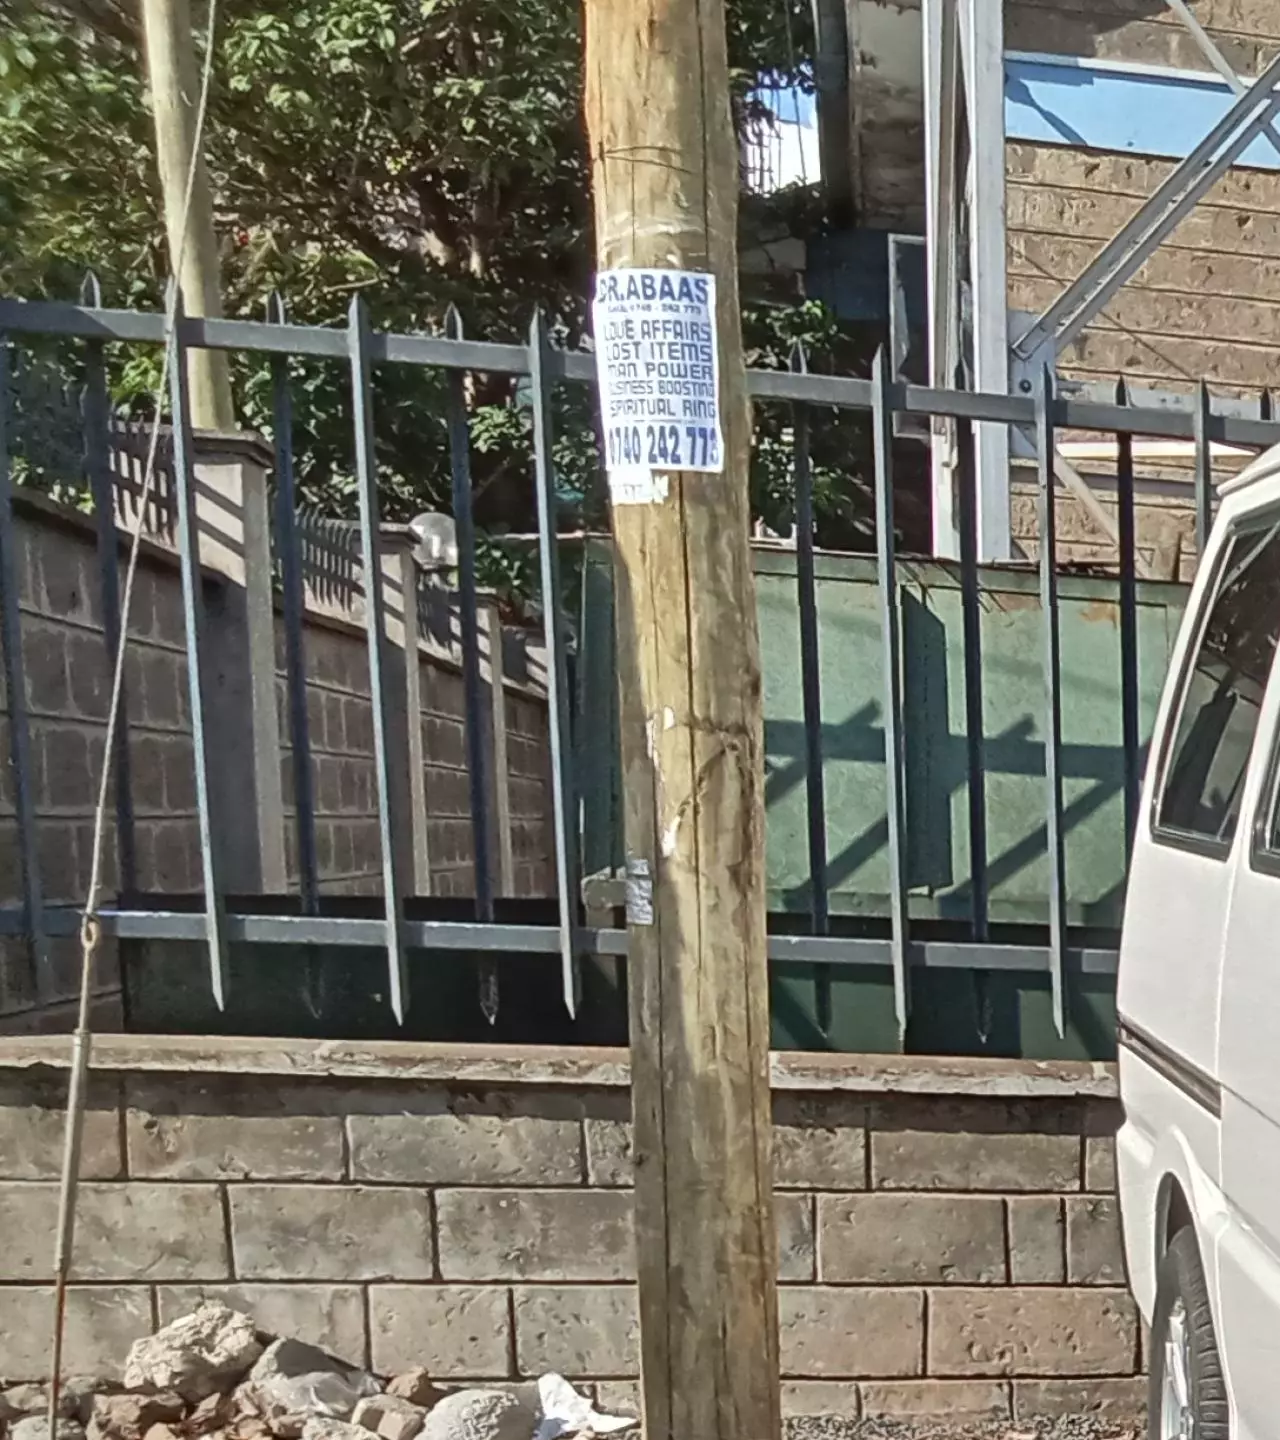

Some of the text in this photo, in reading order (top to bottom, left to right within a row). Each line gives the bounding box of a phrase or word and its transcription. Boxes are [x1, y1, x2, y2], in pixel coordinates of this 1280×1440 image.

[641, 319, 712, 343] AFFAIRS
[606, 342, 713, 363] LOST ITEMS
[645, 362, 713, 381] POWER
[683, 399, 716, 419] RING
[646, 424, 682, 465] 242
